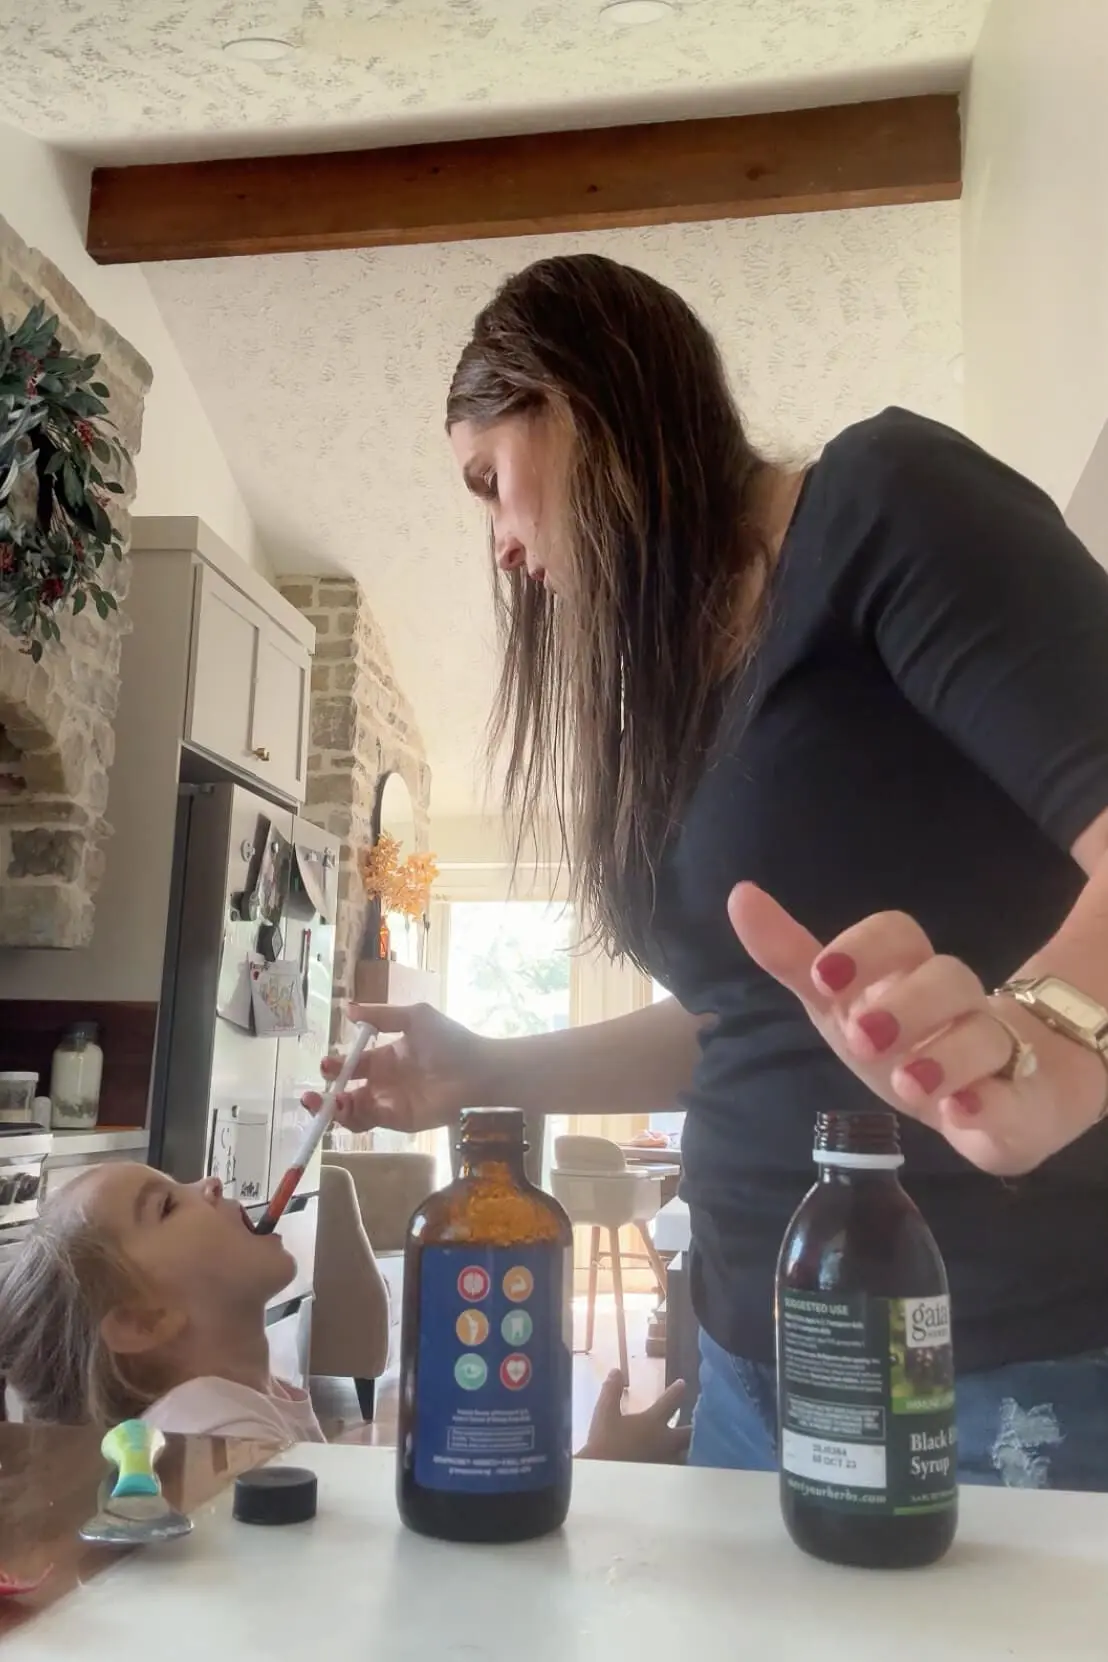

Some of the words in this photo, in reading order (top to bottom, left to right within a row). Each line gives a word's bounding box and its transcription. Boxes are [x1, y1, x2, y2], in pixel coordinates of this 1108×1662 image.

[828, 1304, 849, 1317] USE
[911, 1302, 949, 1342] gaia
[910, 1431, 948, 1452] Black
[823, 1456, 843, 1468] OCT
[910, 1455, 950, 1480] Syrup
